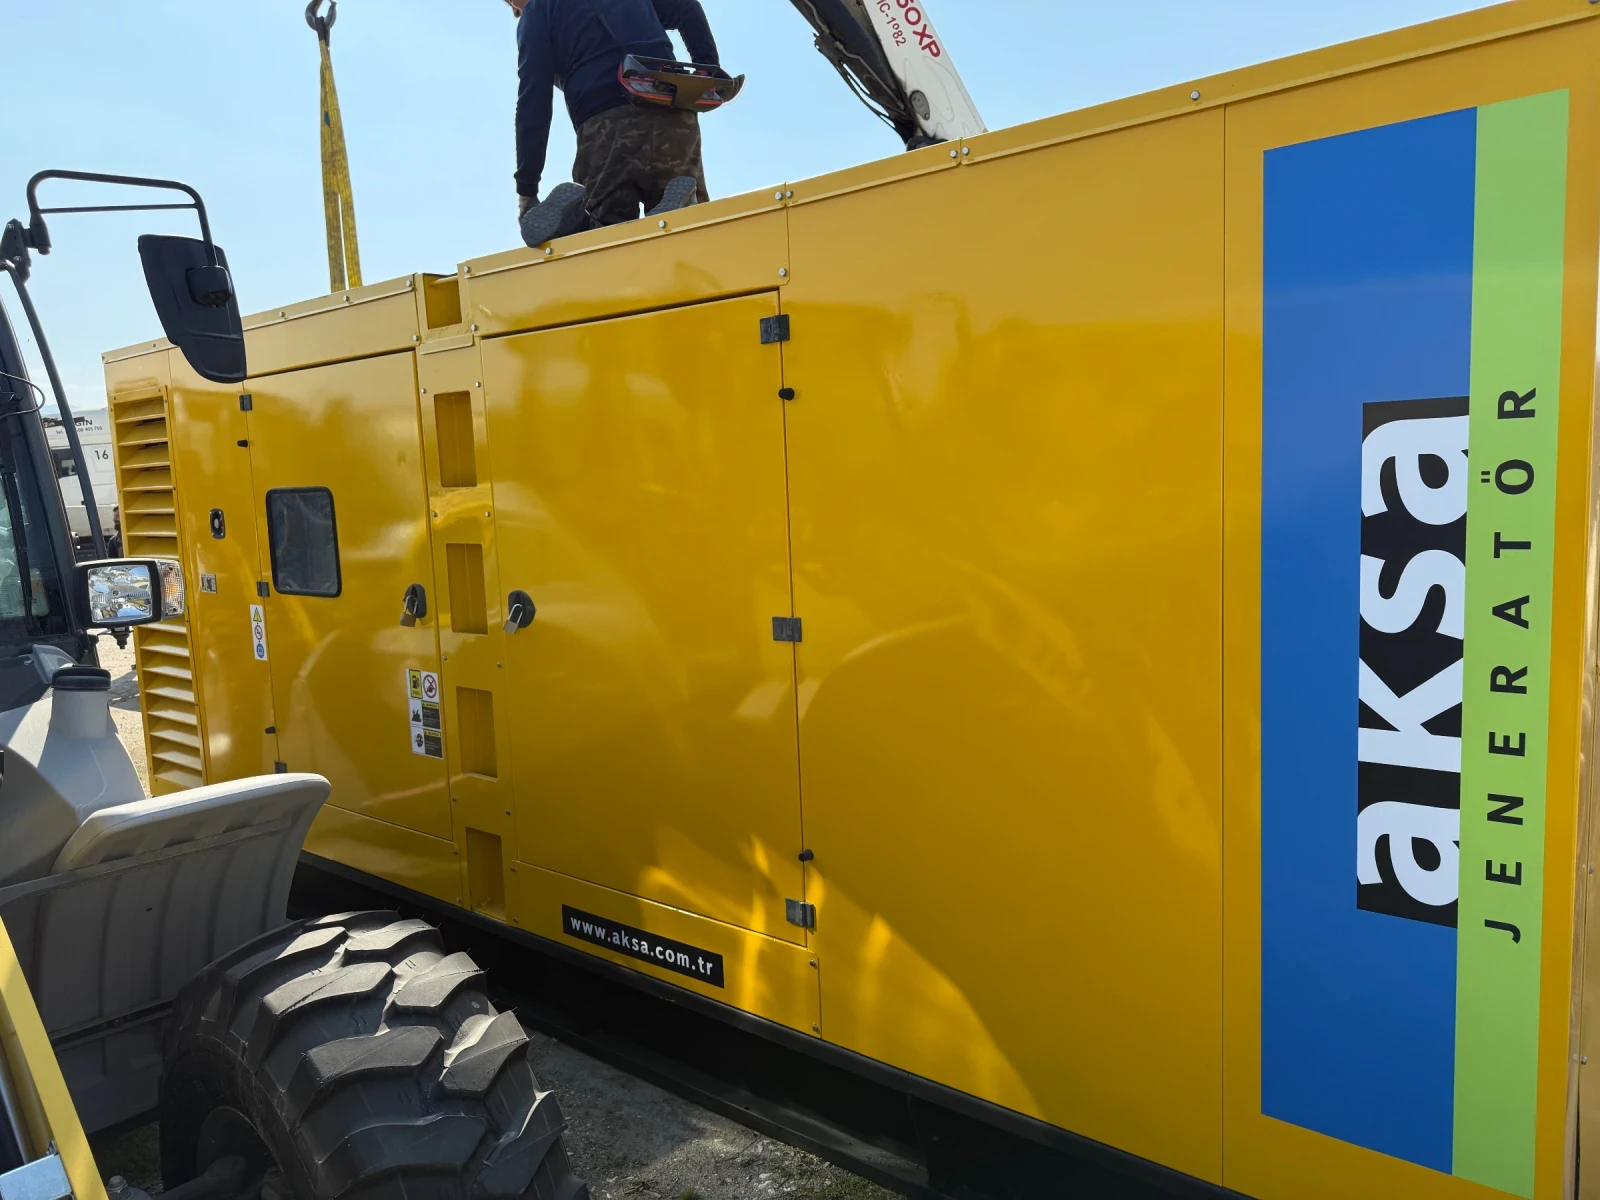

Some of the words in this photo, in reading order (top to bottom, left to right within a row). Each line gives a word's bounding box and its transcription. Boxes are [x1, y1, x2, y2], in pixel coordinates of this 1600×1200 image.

[94, 449, 109, 460] 16
[1357, 414, 1470, 906] aksa
[1481, 387, 1537, 944] JENERATÖR
[570, 916, 714, 976] www.aksa.com.tr
